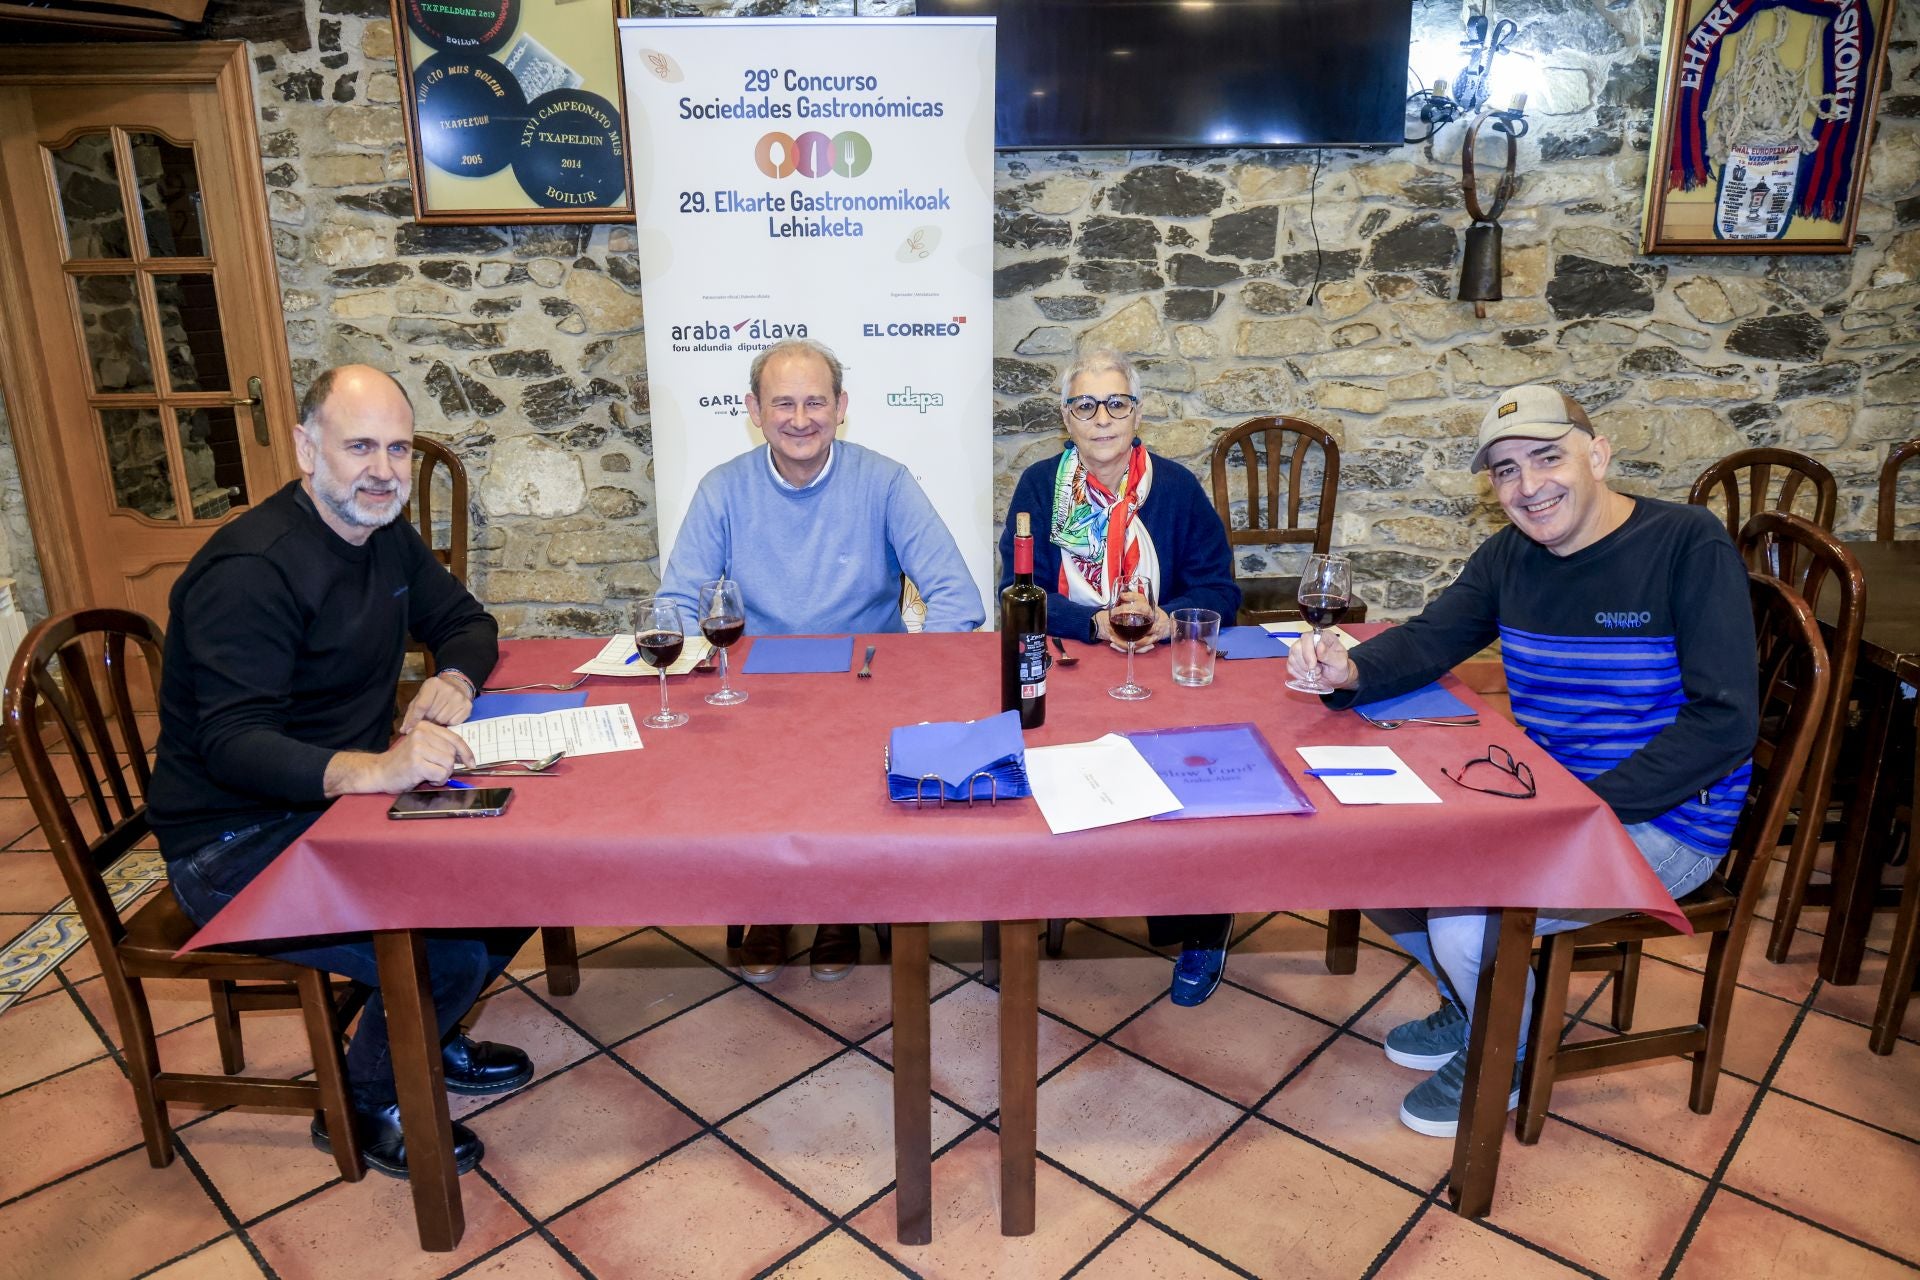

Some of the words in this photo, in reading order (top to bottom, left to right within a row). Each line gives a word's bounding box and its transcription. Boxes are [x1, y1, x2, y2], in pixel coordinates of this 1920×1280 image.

[478, 10, 496, 18] 2019
[426, 69, 444, 85] CTO
[448, 65, 469, 76] MUS
[783, 68, 878, 92] Concurso
[679, 97, 793, 120] Sociedades
[796, 95, 945, 119] Gastronómicas
[521, 117, 540, 148] XXVI
[538, 101, 611, 129] CAMPEONATO
[608, 130, 622, 156] MUS
[538, 132, 603, 145] TXAPELDUN
[461, 154, 483, 165] 2005
[561, 158, 582, 169] 2014
[545, 185, 598, 204] BOILUR
[679, 191, 710, 213] 29.
[715, 190, 786, 213] Elkarte
[790, 188, 951, 212] Gastronomikoak
[769, 214, 864, 238] Lehiaketa
[671, 320, 731, 341] araba
[749, 319, 808, 339] álava
[863, 323, 885, 337] EL
[887, 323, 961, 337] CORREO
[672, 343, 691, 353] foru
[693, 342, 733, 353] aldundia
[699, 394, 743, 408] GARL
[887, 385, 944, 414] udapa
